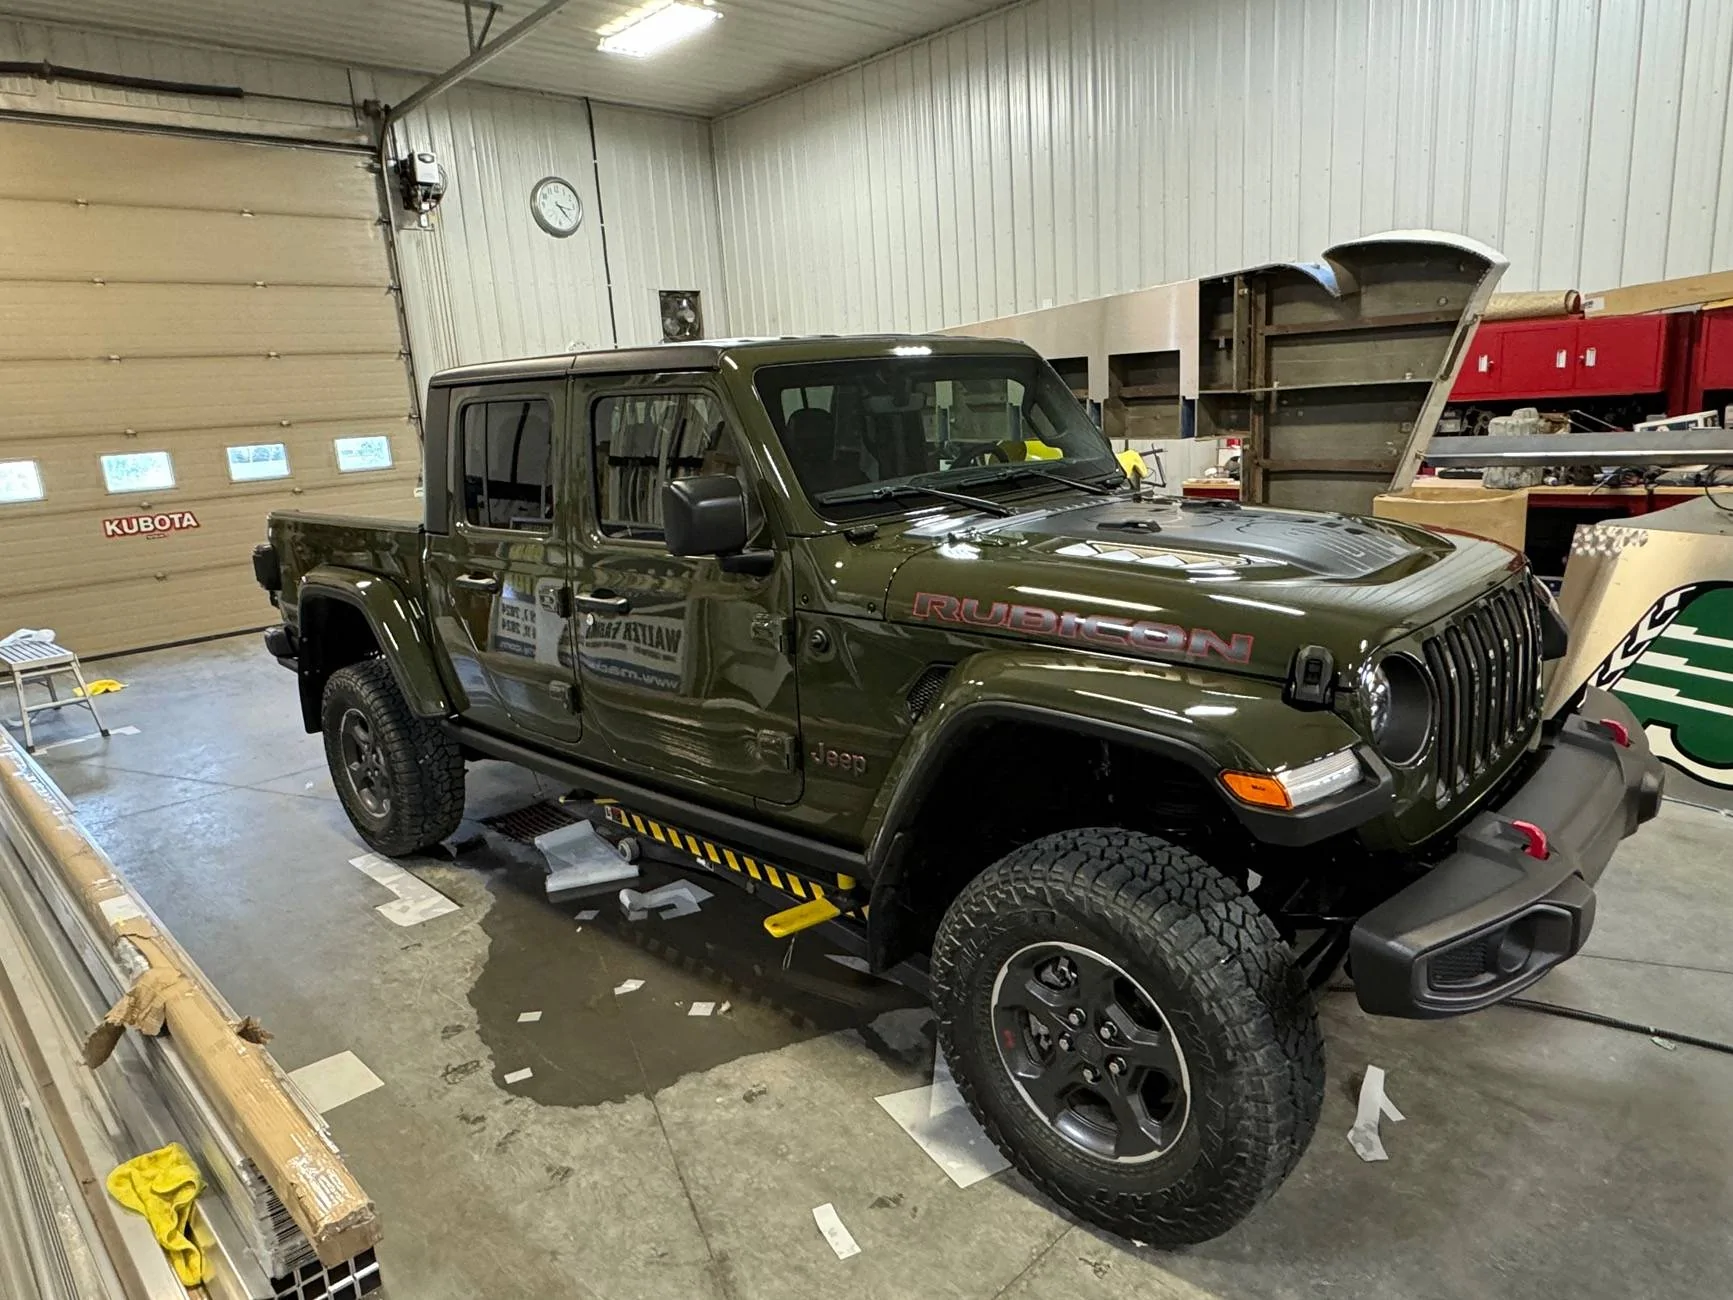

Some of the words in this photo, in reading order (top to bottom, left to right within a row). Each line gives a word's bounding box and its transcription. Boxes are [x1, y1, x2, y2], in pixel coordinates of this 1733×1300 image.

[104, 512, 198, 537] KUBOTA
[913, 592, 1254, 664] RUBICON
[810, 742, 866, 776] Jeep
